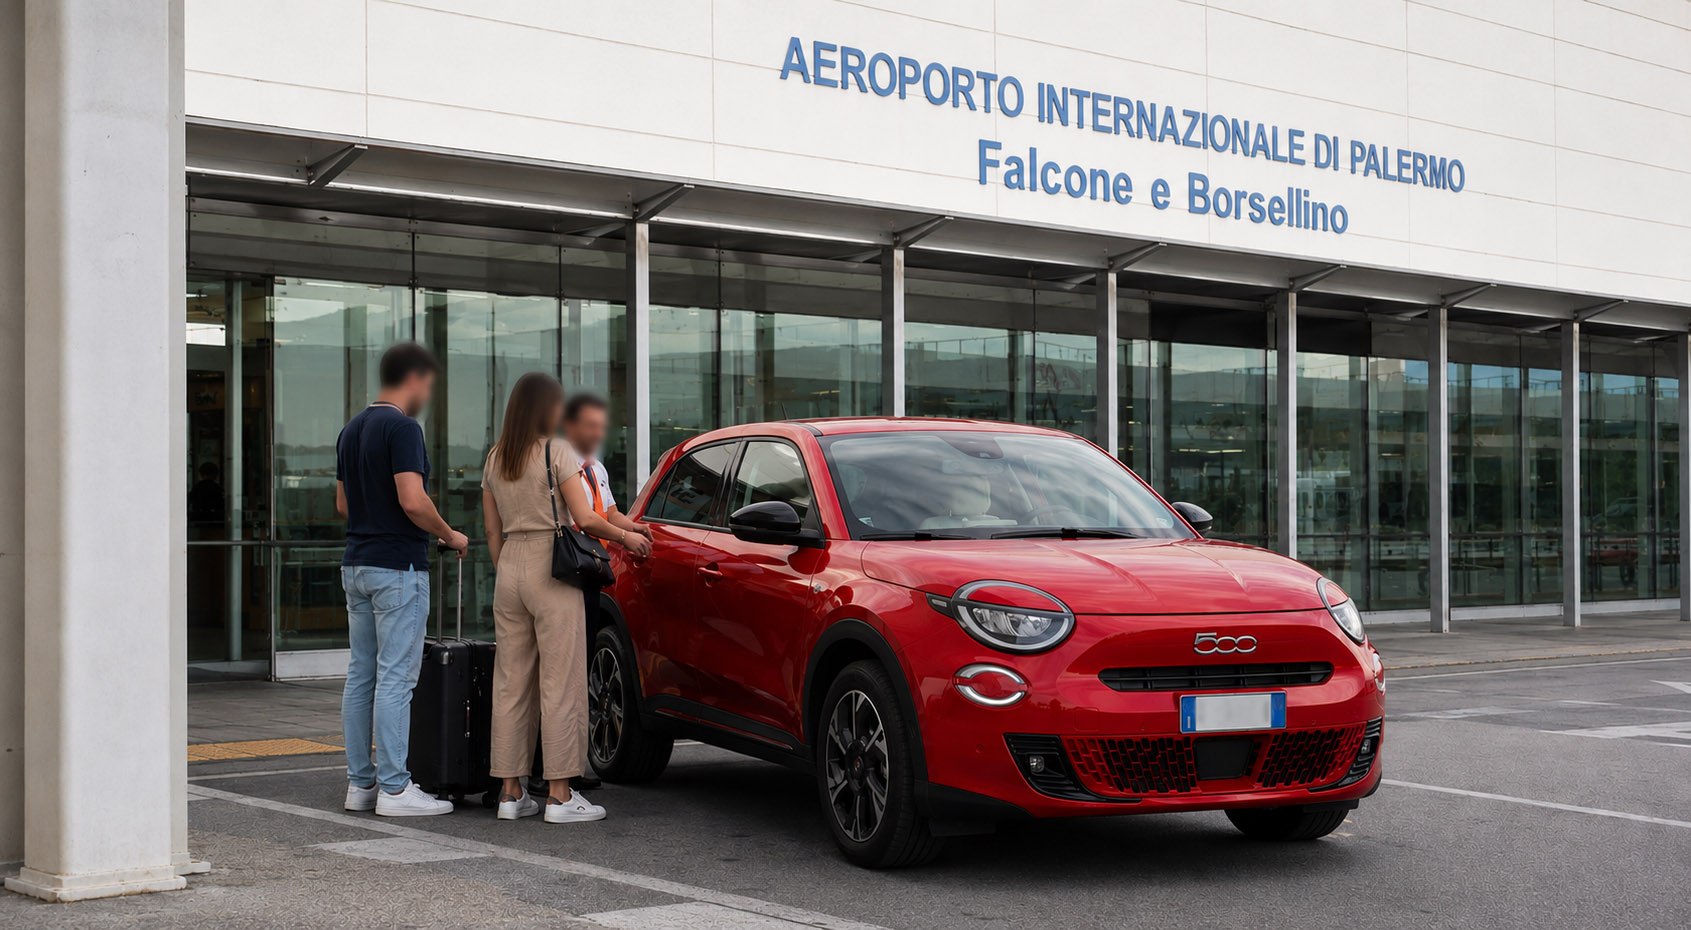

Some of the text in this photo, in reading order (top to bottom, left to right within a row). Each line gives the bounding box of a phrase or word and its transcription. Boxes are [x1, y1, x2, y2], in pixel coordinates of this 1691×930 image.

[780, 36, 1466, 193] AEROPORTO INTERNAZIONALE DI PALERMO
[978, 138, 1350, 234] Falcone e Borsellino
[1193, 632, 1258, 655] 500
